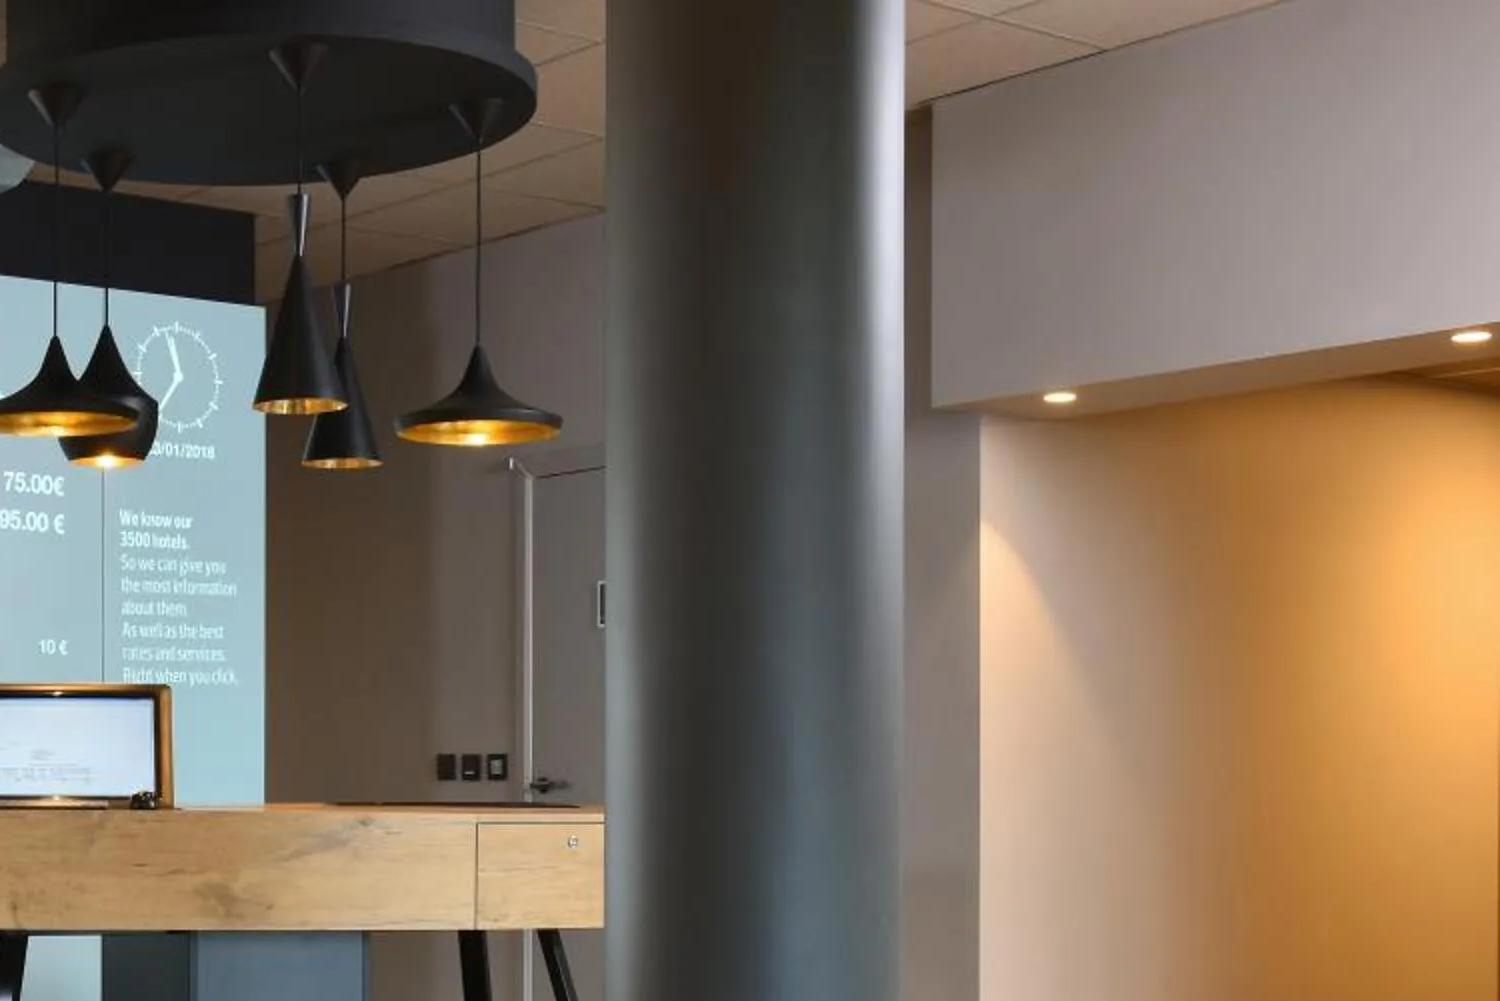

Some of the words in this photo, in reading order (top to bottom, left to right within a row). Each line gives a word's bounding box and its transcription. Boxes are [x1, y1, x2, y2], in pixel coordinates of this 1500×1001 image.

[4, 471, 65, 497] 75.00€
[119, 508, 140, 528] We
[141, 511, 172, 529] know
[173, 515, 193, 530] our
[119, 530, 151, 548] 3500
[120, 553, 137, 572] So
[138, 558, 156, 572] we
[38, 639, 56, 655] 10
